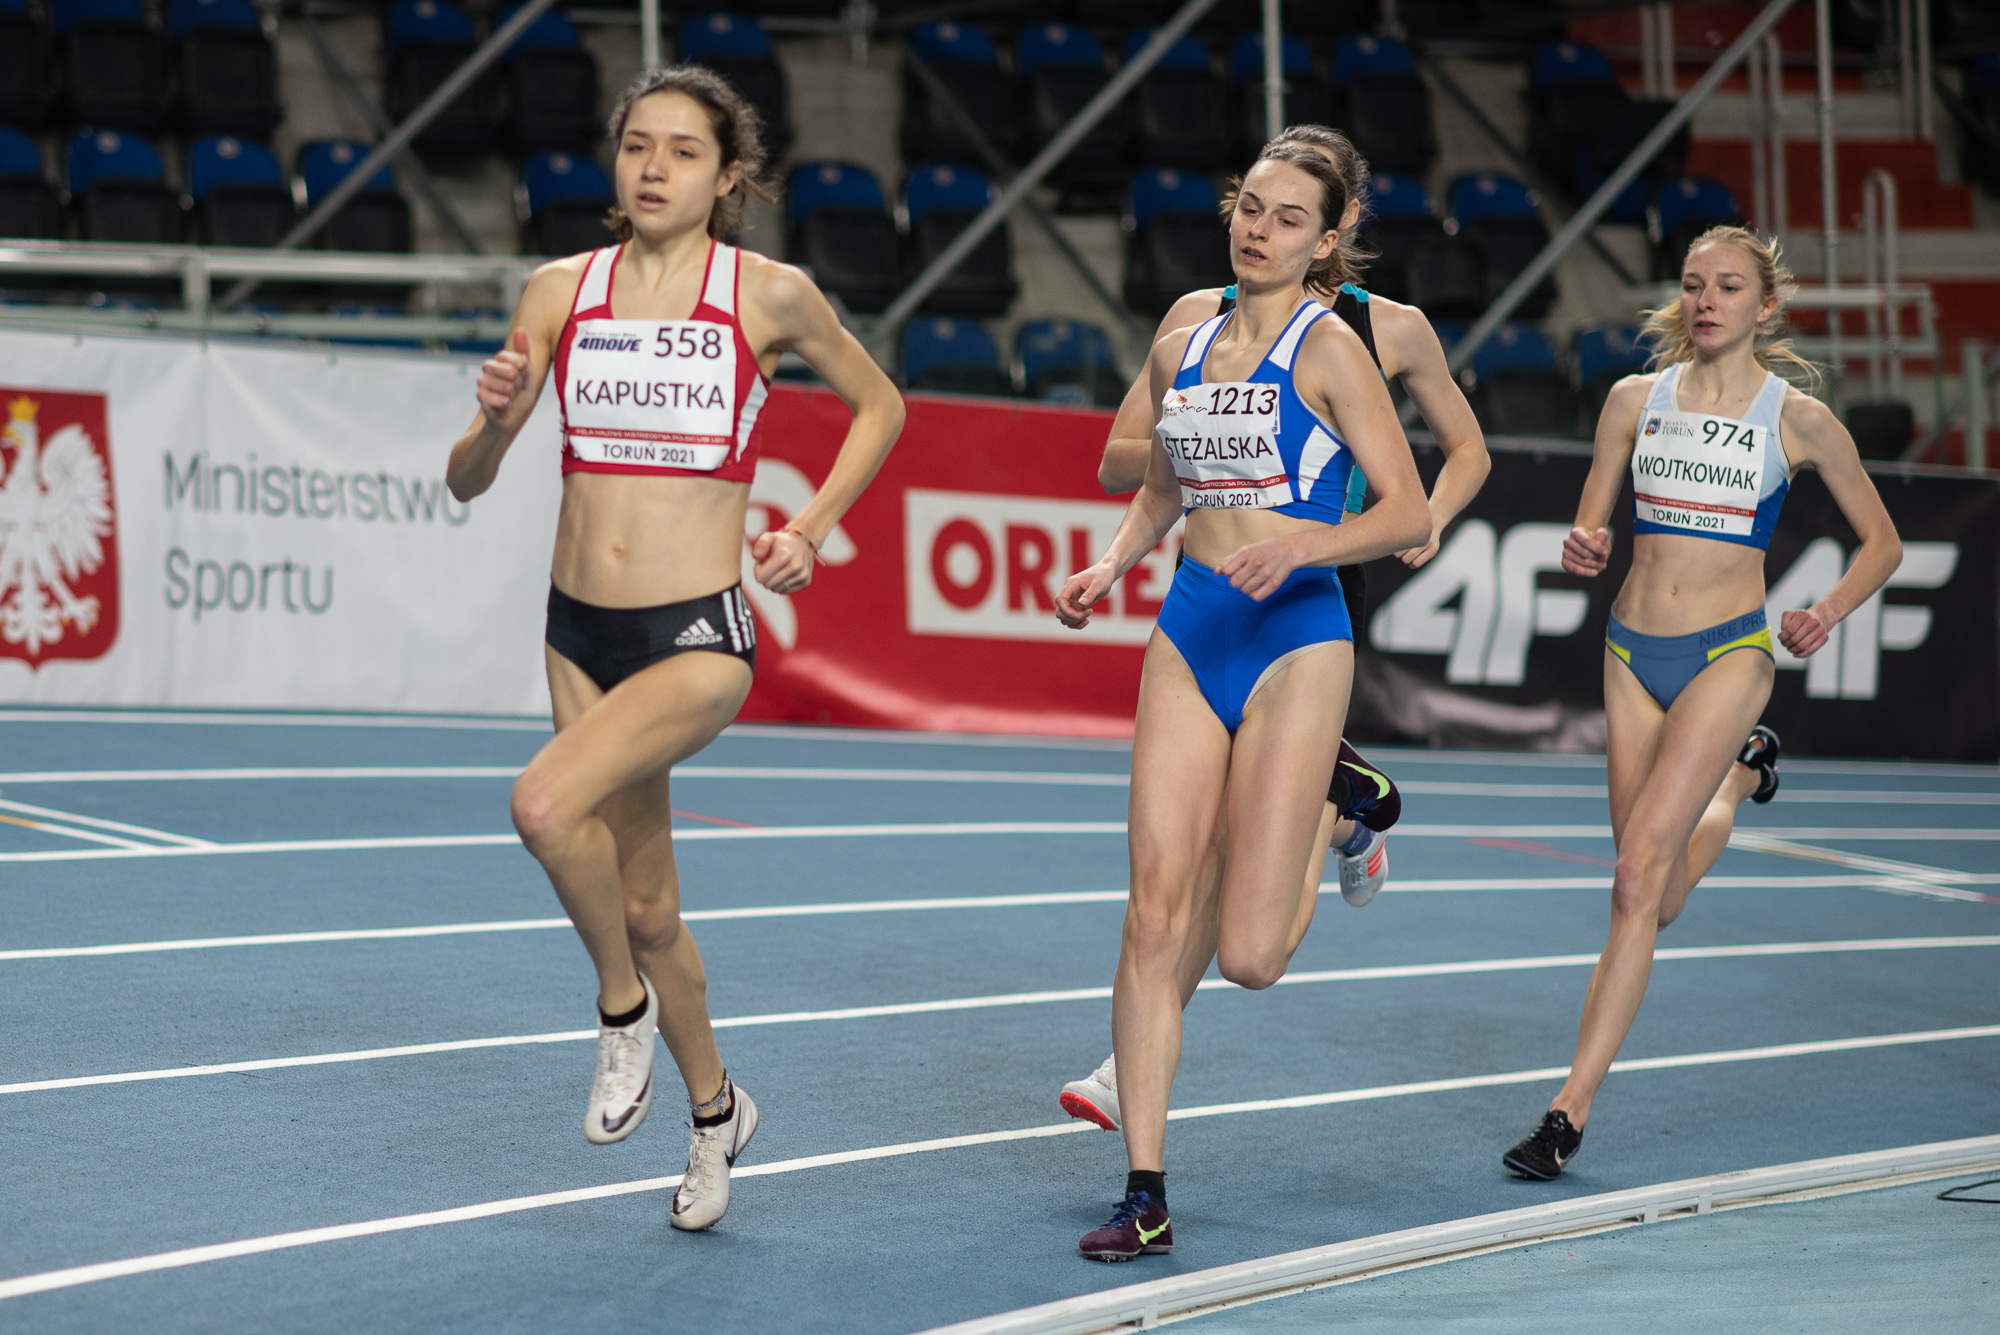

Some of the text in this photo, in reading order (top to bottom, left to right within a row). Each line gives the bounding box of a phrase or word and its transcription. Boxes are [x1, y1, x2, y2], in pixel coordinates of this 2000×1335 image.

[654, 327, 722, 359] 558
[576, 379, 726, 409] KAPUSTKA
[1208, 387, 1278, 415] 1213
[1662, 425, 1695, 437] TORUŃ
[1702, 420, 1755, 452] 974
[603, 441, 695, 463] TORUŃ 2021
[1165, 431, 1274, 465] STĘŻALSKA
[1638, 454, 1757, 491] WOJTKOWIAK
[1229, 493, 1259, 507] 2021
[1652, 510, 1725, 529] TORUŃ 2021
[931, 515, 1185, 618] ORLE
[163, 547, 334, 622] Sportu
[1369, 518, 1612, 687] 4F
[1765, 536, 1961, 700] 4F
[674, 633, 723, 646] adidas
[1700, 611, 1766, 648] NIKE PRO
